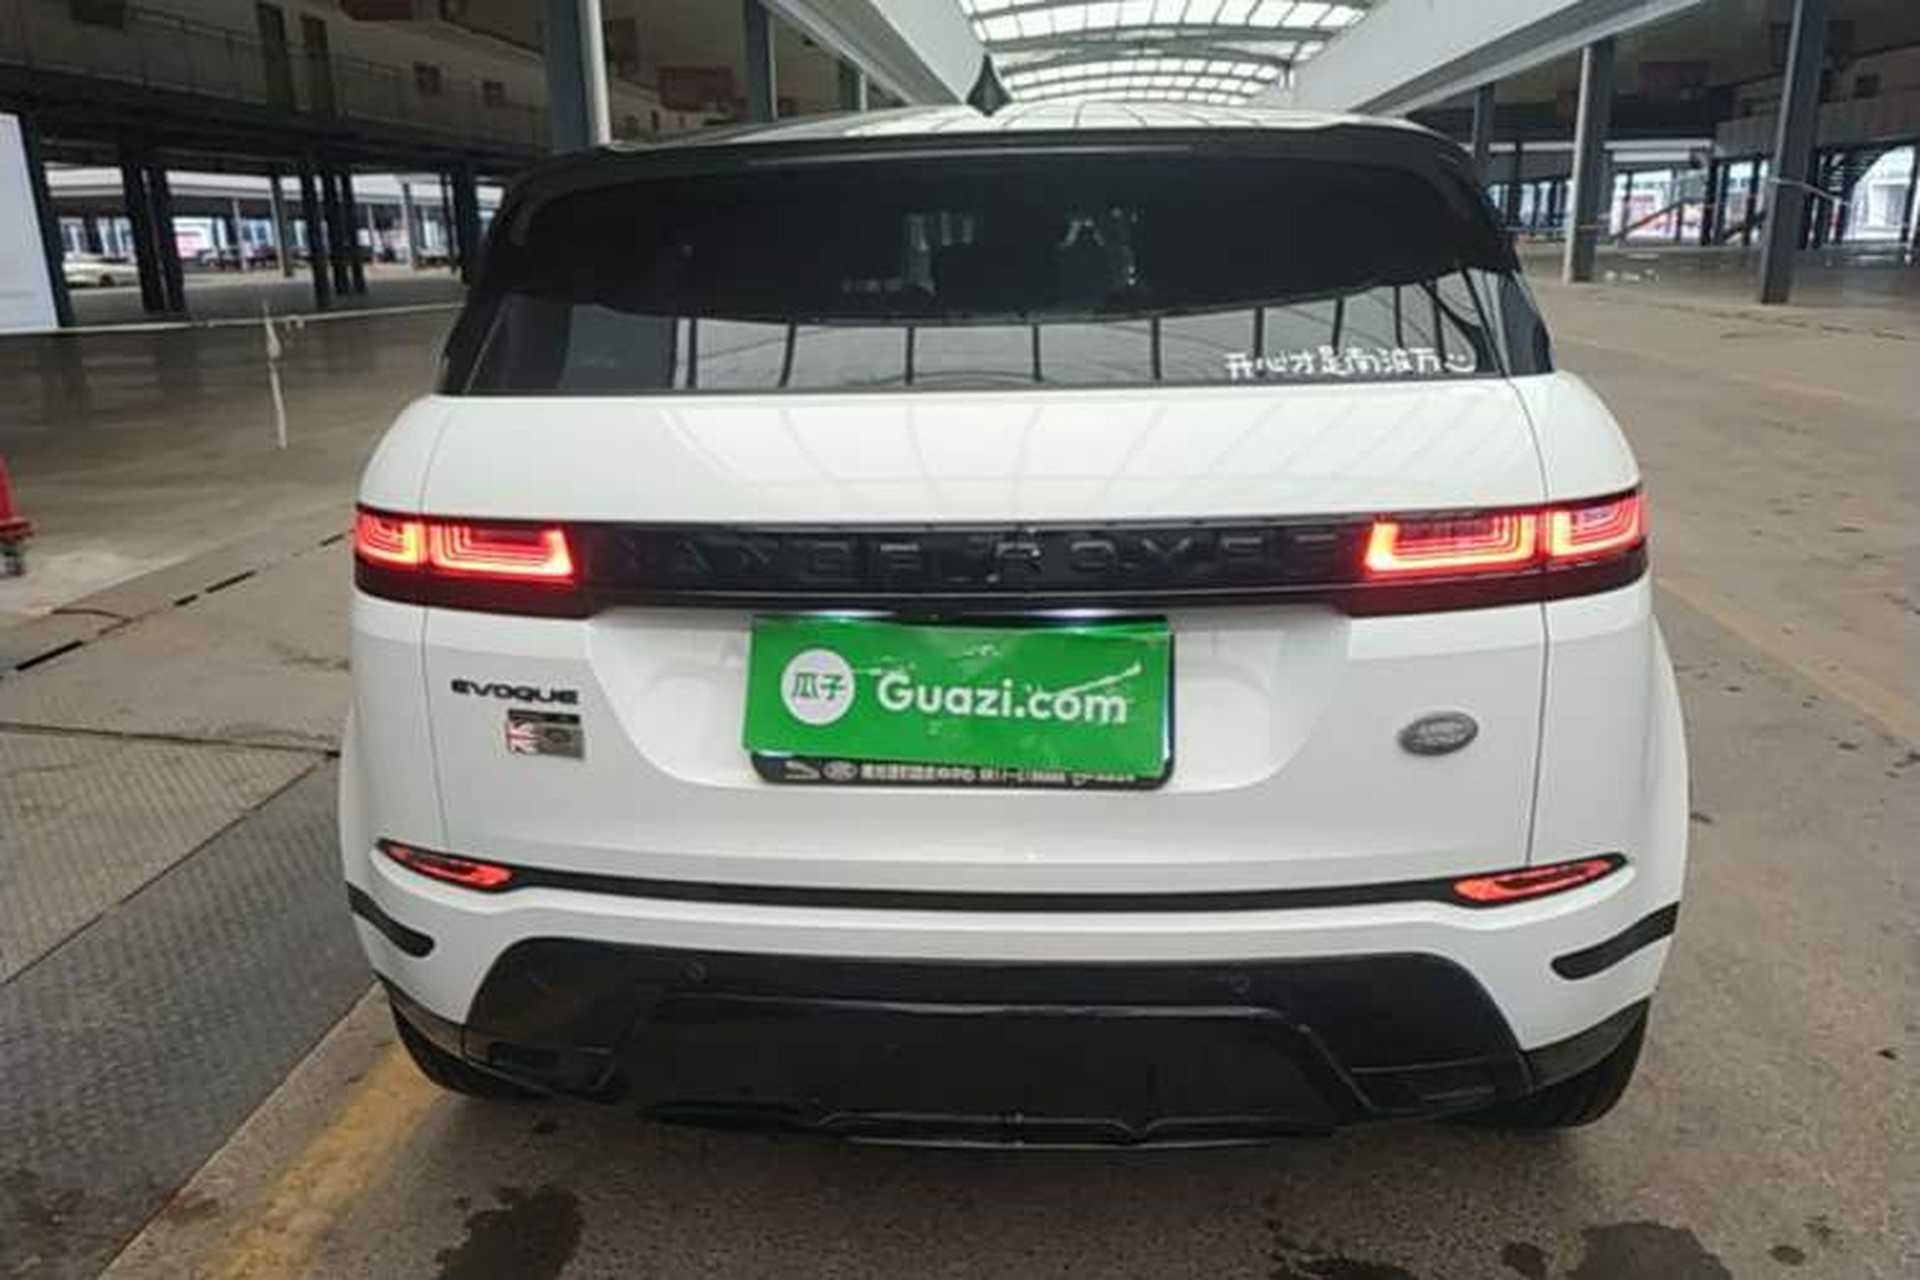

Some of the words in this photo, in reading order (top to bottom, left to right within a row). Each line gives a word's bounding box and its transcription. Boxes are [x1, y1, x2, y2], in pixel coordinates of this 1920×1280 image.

[451, 679, 578, 704] EVOQUE
[791, 672, 845, 700] 瓜子
[877, 675, 1127, 724] Guazi.com
